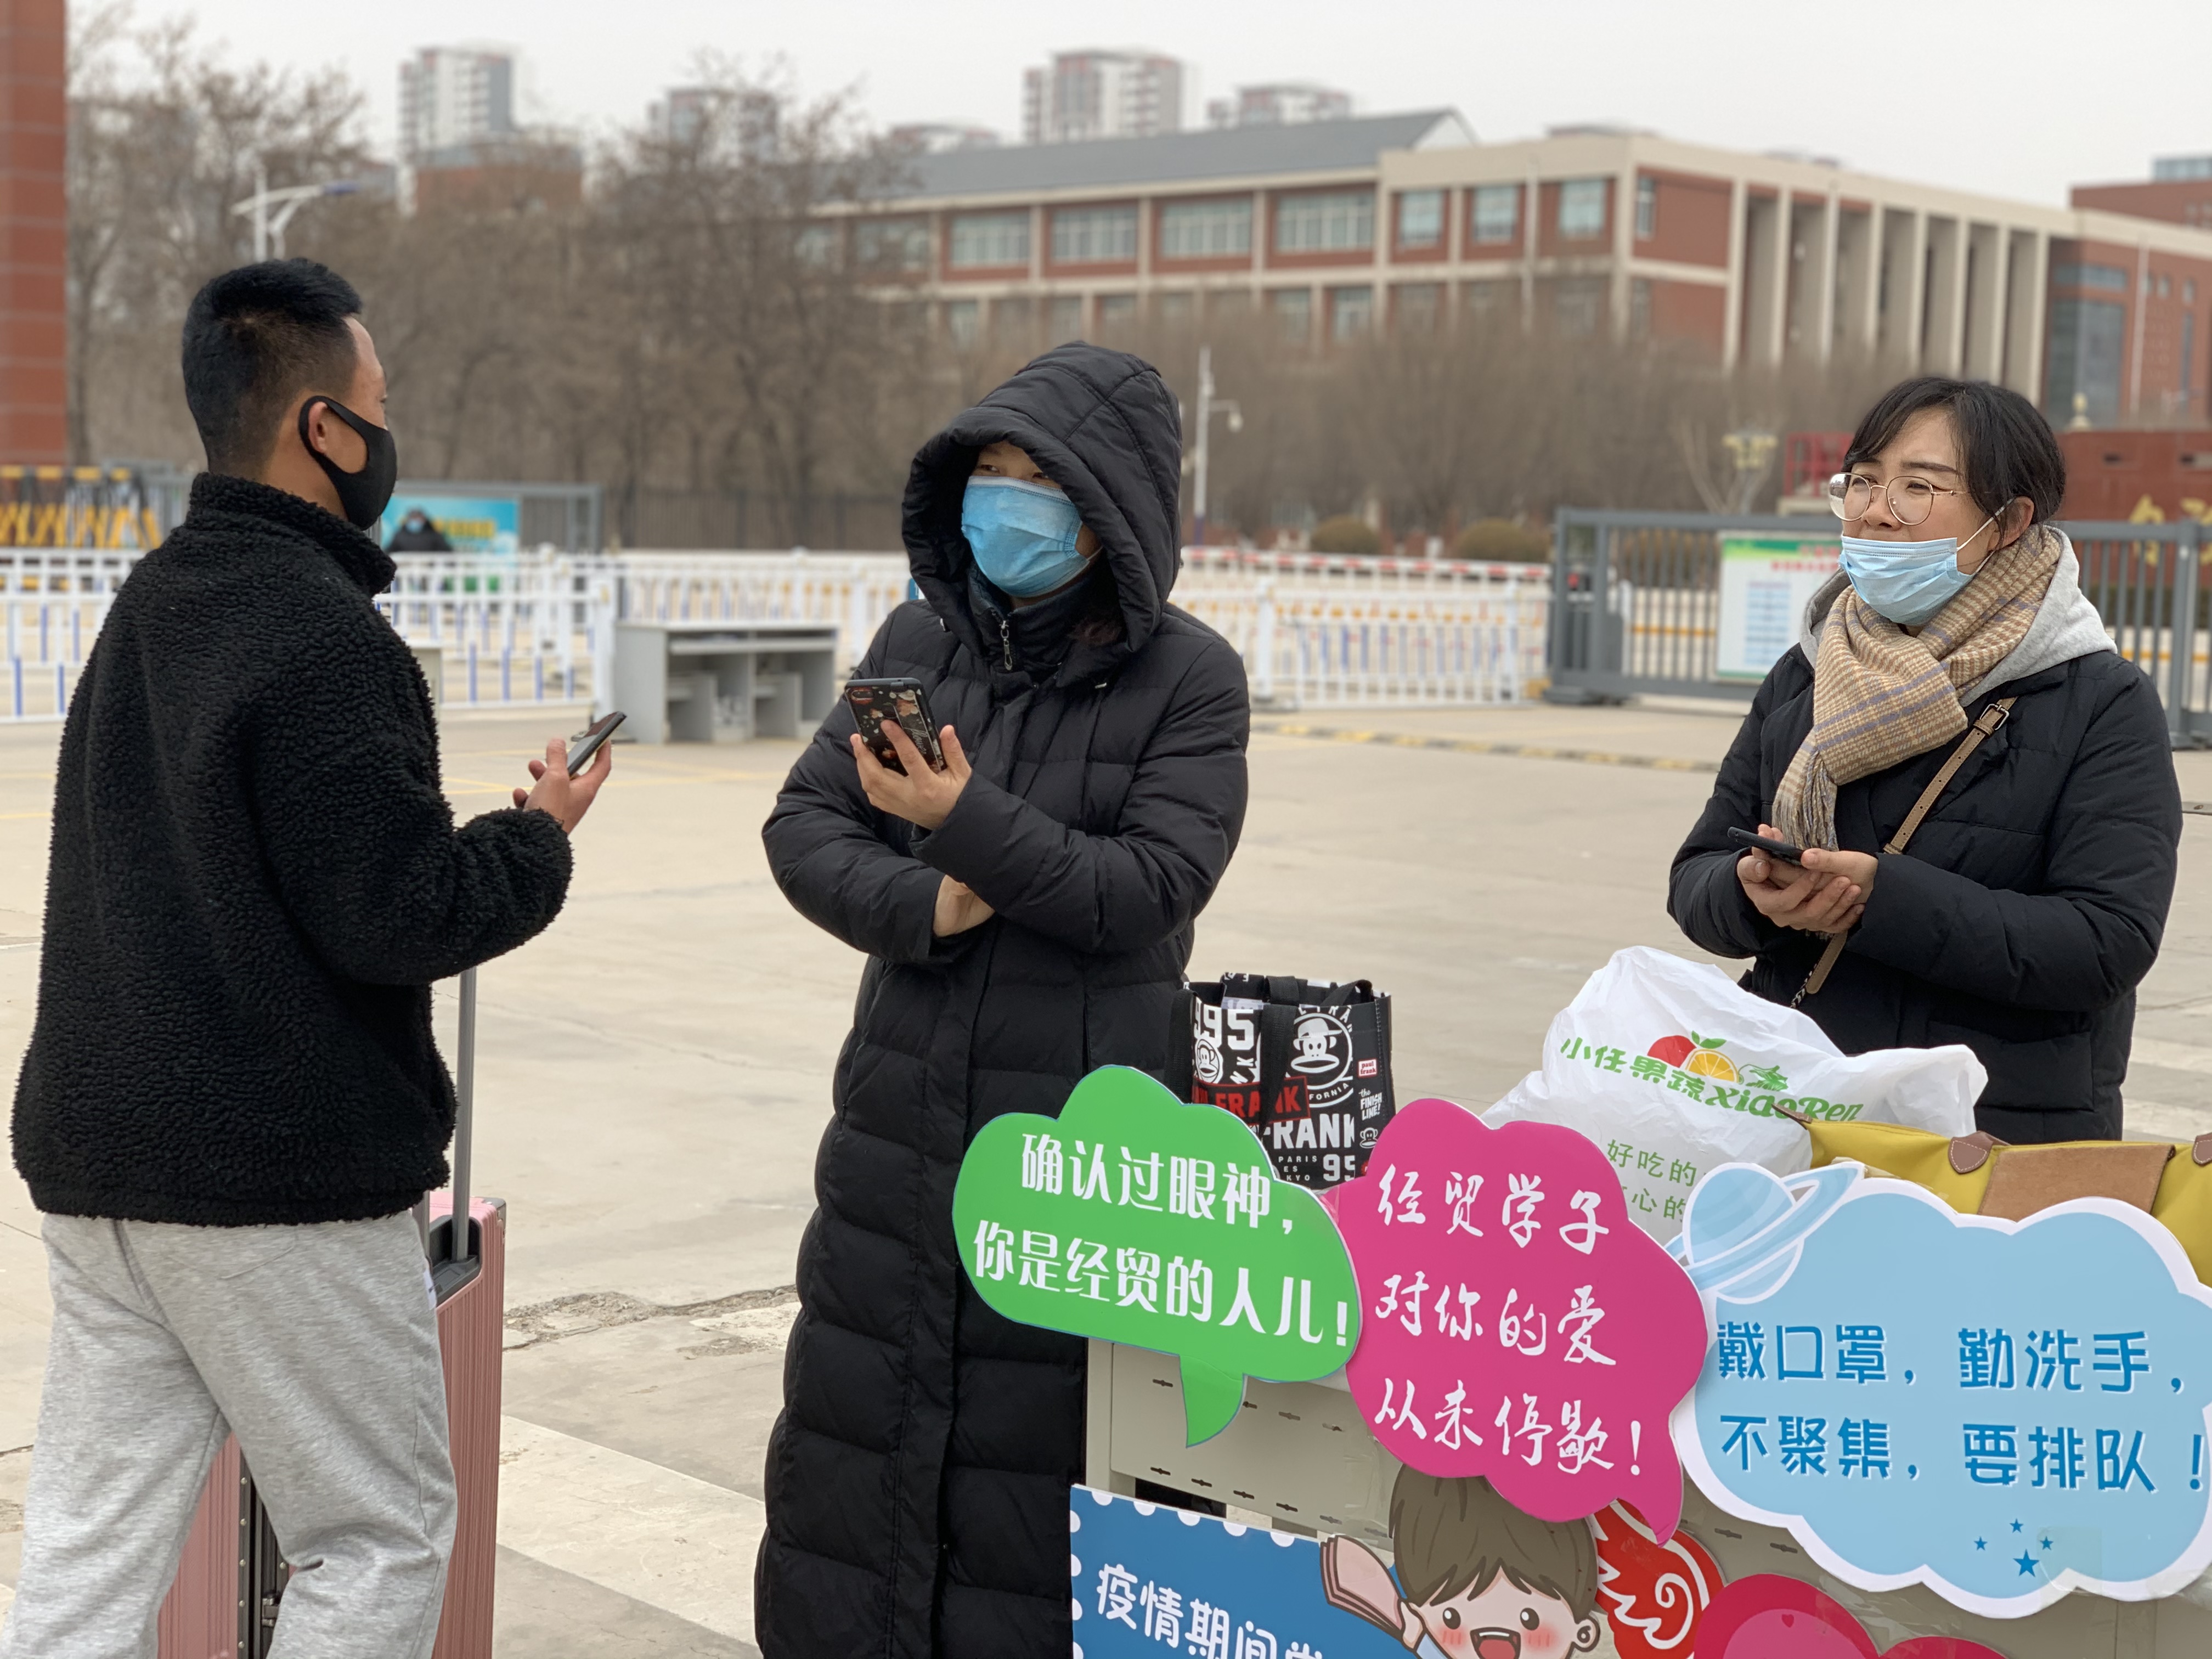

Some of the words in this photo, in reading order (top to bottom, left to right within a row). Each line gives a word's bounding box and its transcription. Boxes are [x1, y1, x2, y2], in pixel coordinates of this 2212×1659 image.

[1358, 1088, 1371, 1097] the
[1362, 1060, 1374, 1069] paul
[1560, 1037, 1705, 1103] 小任果蔬
[1361, 1092, 1383, 1110] FINISH
[1362, 1103, 1381, 1121] LINE!
[1022, 1133, 1293, 1234] 确认过眼神，
[1607, 1139, 1707, 1187] 好吃的
[1378, 1164, 1609, 1255] 经贸学子
[1622, 1186, 1686, 1223] 心的
[974, 1220, 1348, 1346] 你是经贸的人儿！
[1375, 1271, 1616, 1365] 对你的爱
[1374, 1378, 1640, 1476] 从未停歇！
[1097, 1564, 1323, 1659] 疫情期间
